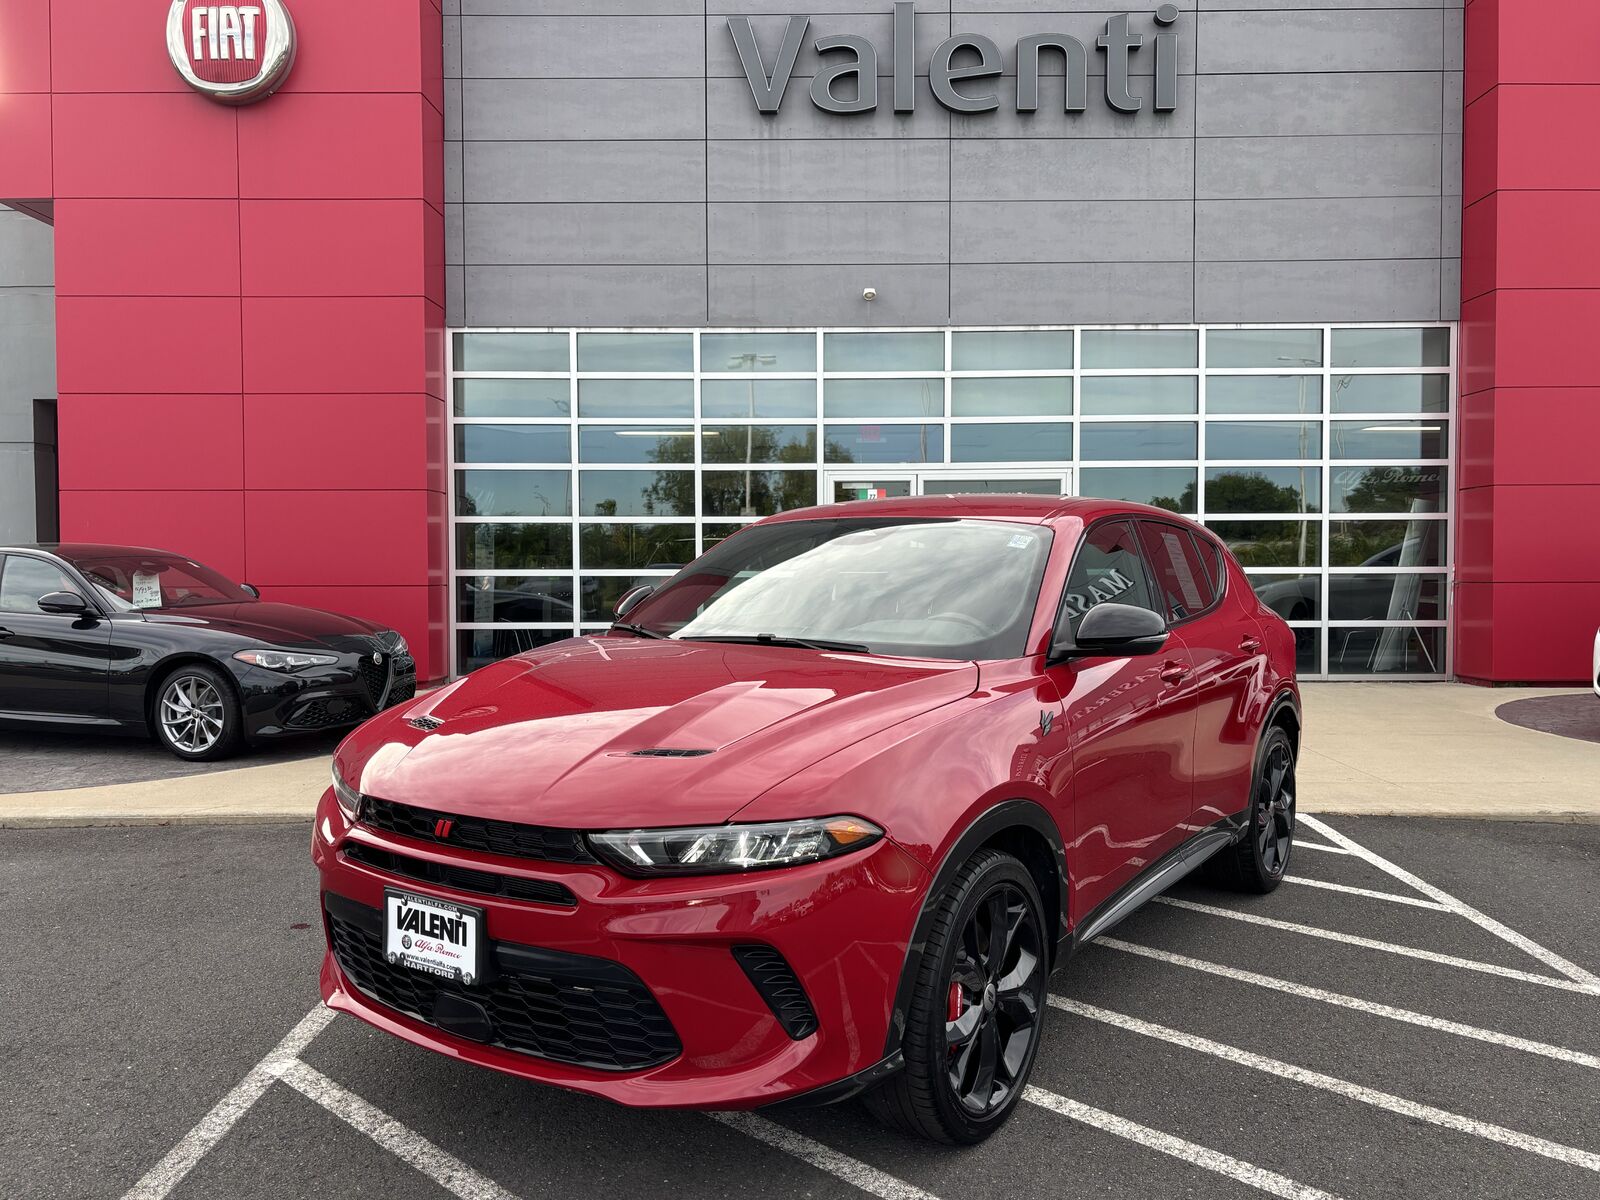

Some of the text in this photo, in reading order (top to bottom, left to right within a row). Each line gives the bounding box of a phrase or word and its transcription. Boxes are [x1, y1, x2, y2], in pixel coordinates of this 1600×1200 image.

[191, 6, 261, 60] FIAT
[726, 2, 1180, 115] Valenti
[403, 894, 458, 912] VALENTIALFA.COM
[414, 939, 462, 959] Alfa Romeo
[403, 960, 455, 980] HARTFORD
[405, 953, 458, 972] www.valentialfa.com
